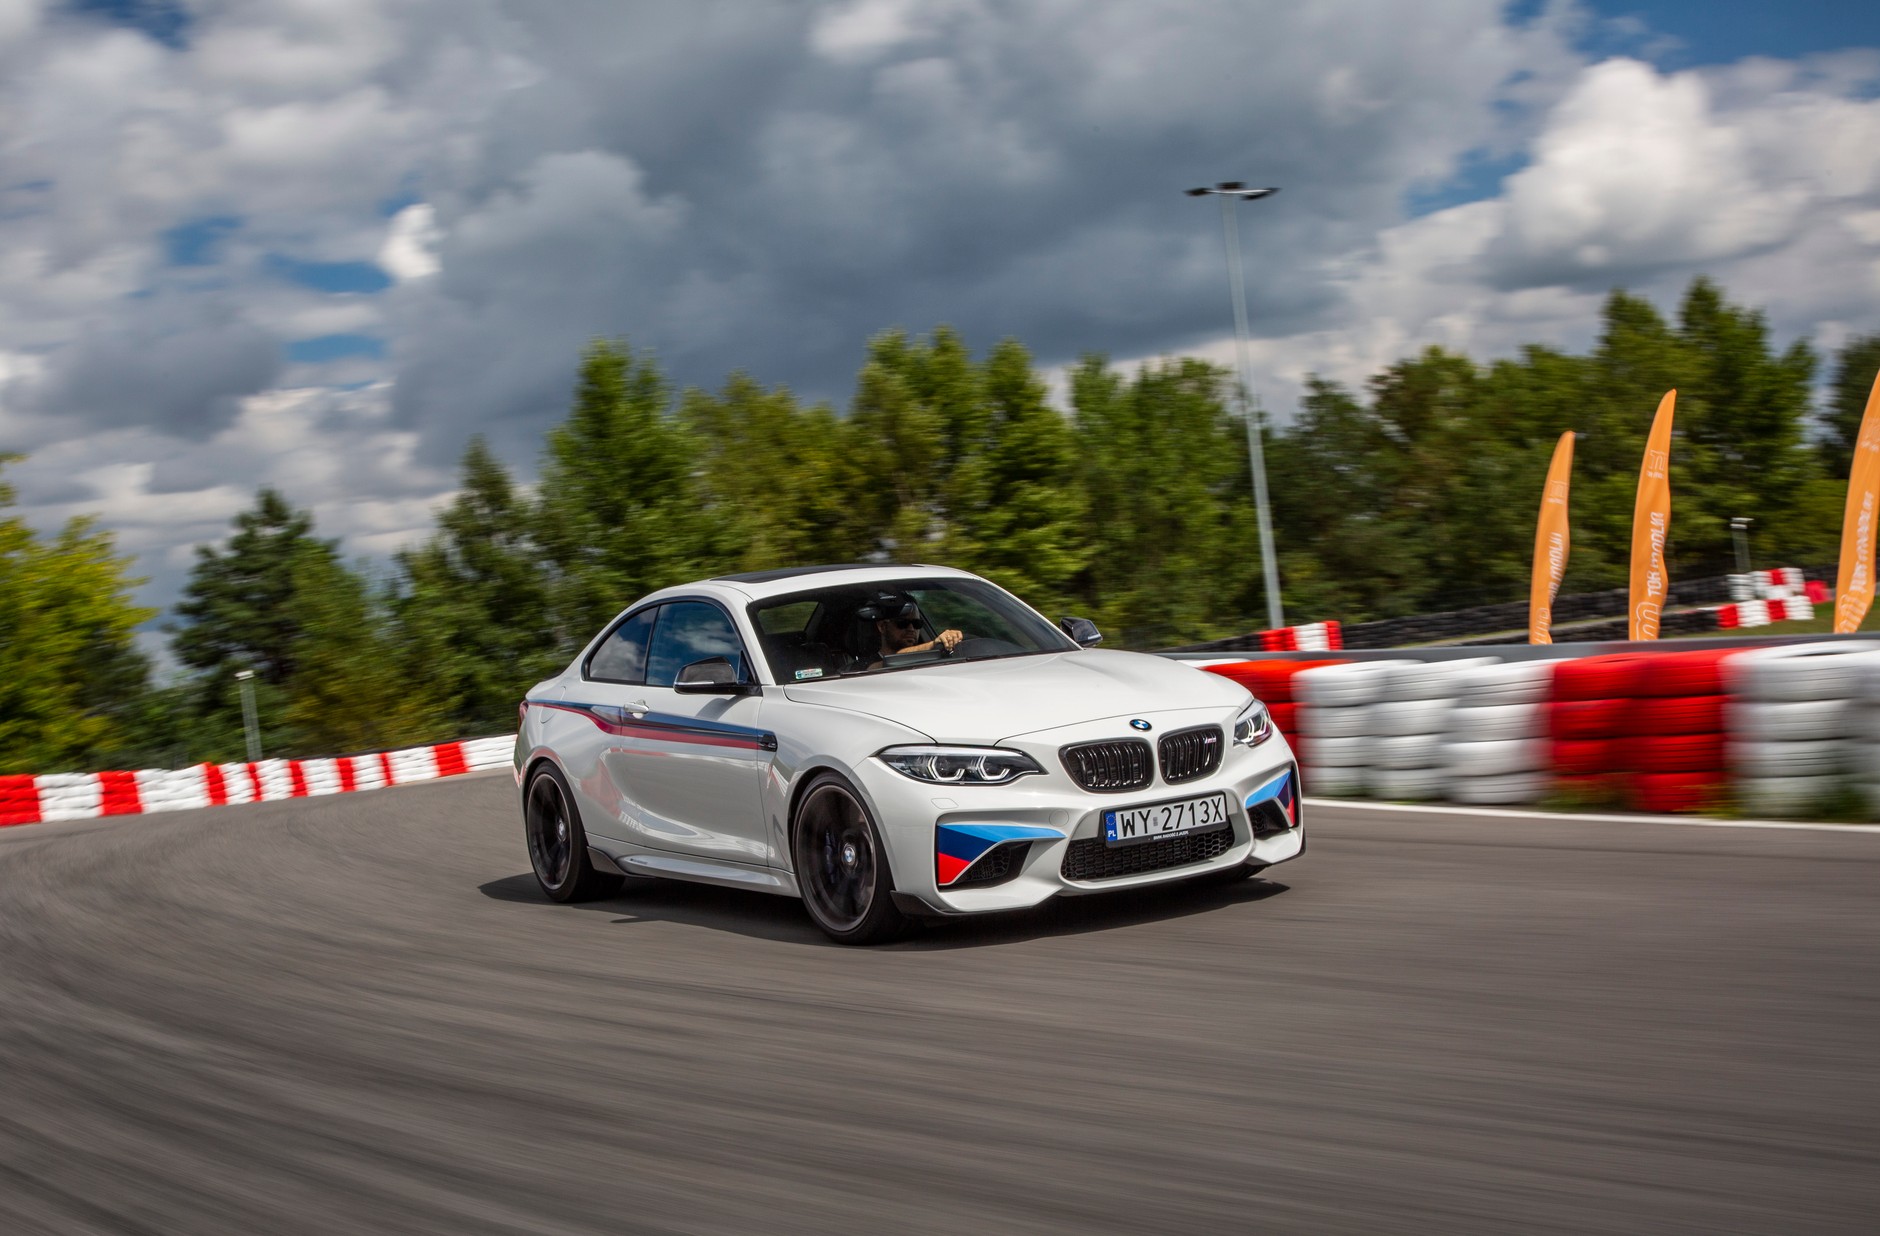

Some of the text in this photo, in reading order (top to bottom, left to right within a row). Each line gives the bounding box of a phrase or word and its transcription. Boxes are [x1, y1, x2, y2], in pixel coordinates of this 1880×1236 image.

[1647, 571, 1662, 597] TOR
[1120, 797, 1223, 837] WY 2713X
[1107, 830, 1117, 838] PL
